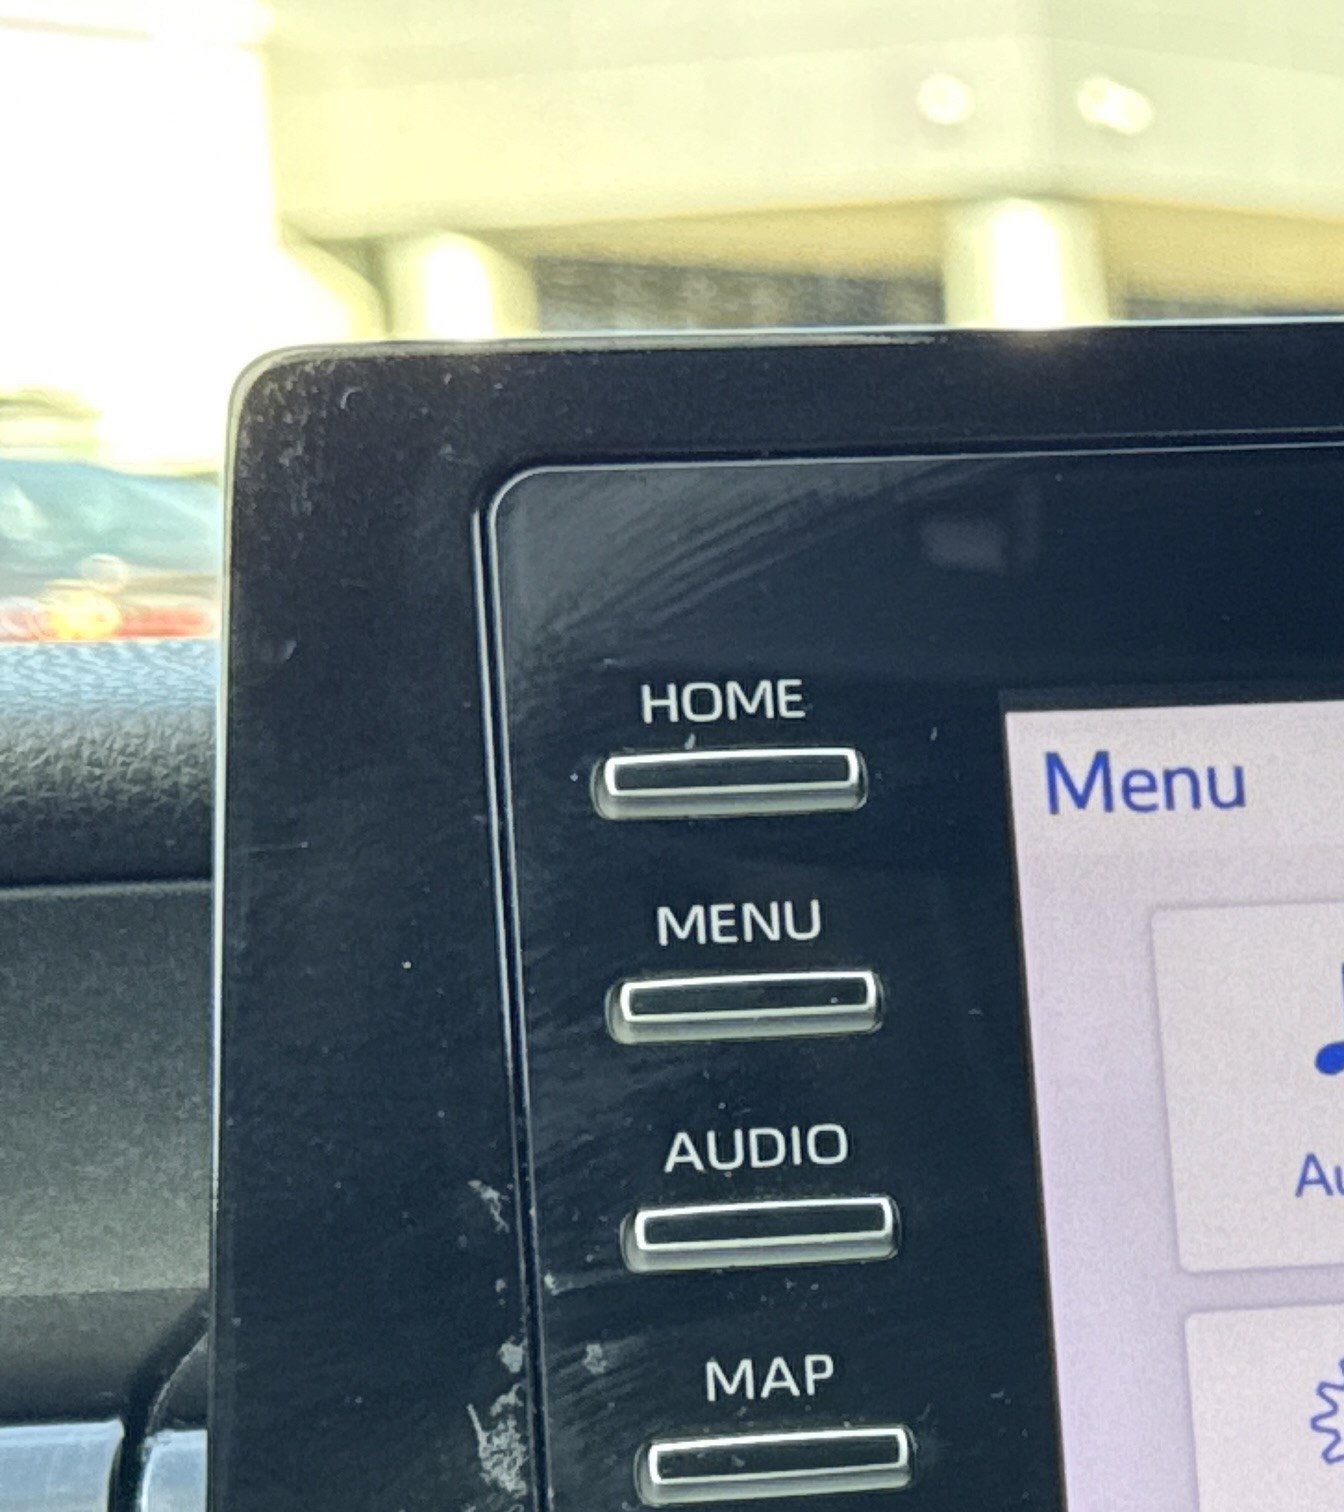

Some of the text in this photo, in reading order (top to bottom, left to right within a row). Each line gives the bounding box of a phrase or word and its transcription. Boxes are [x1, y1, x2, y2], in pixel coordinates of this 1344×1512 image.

[641, 679, 806, 724] HOME
[1044, 750, 1246, 815] Menu
[657, 899, 821, 946] MENU
[664, 1123, 849, 1172] AUDIO
[705, 1354, 834, 1402] MAP
